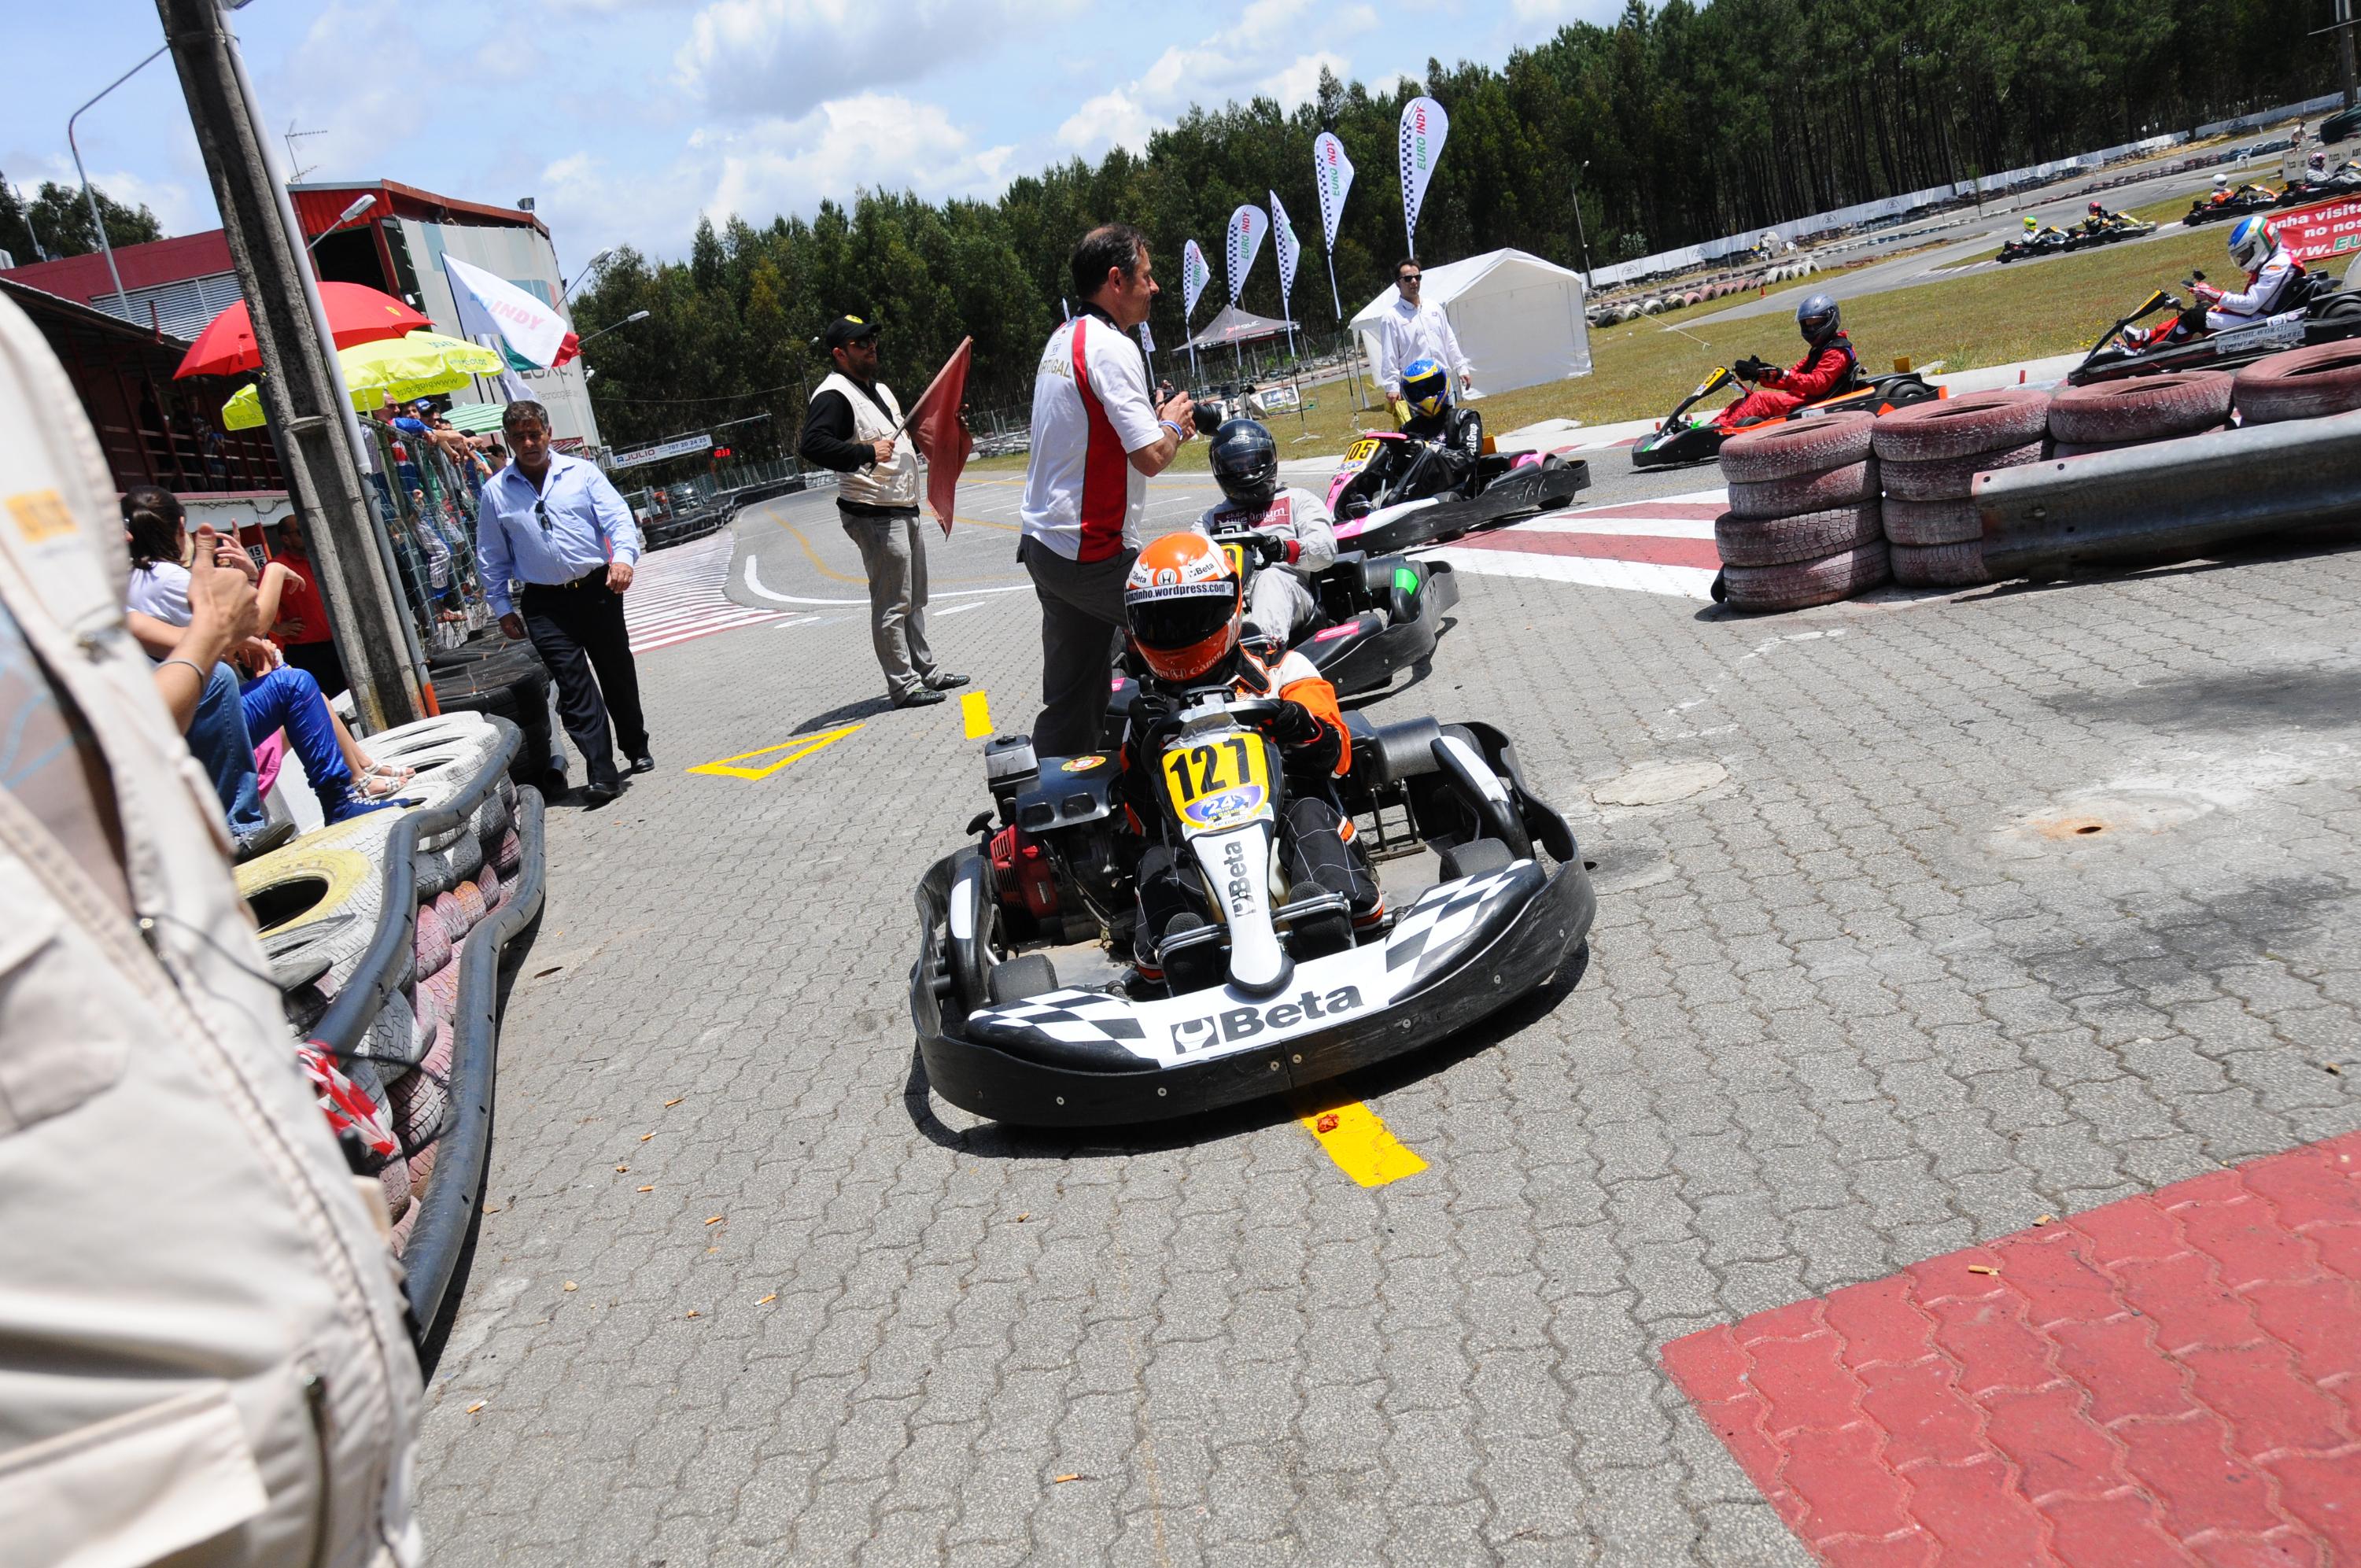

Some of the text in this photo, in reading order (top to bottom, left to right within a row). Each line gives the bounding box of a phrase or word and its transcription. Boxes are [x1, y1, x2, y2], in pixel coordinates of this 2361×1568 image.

[1416, 106, 1426, 170] EURO INDY
[1326, 139, 1340, 196] EURO INDY
[1241, 212, 1250, 260] EURO INDY
[2304, 227, 2327, 238] no
[1193, 264, 1201, 287] EURO
[1344, 441, 1373, 462] 105
[249, 546, 261, 557] 15
[1194, 562, 1216, 577] Beta
[1190, 650, 1223, 675] Canon
[1169, 737, 1251, 803] 127
[1223, 841, 1252, 897] Beta
[1219, 985, 1365, 1042] Beta
